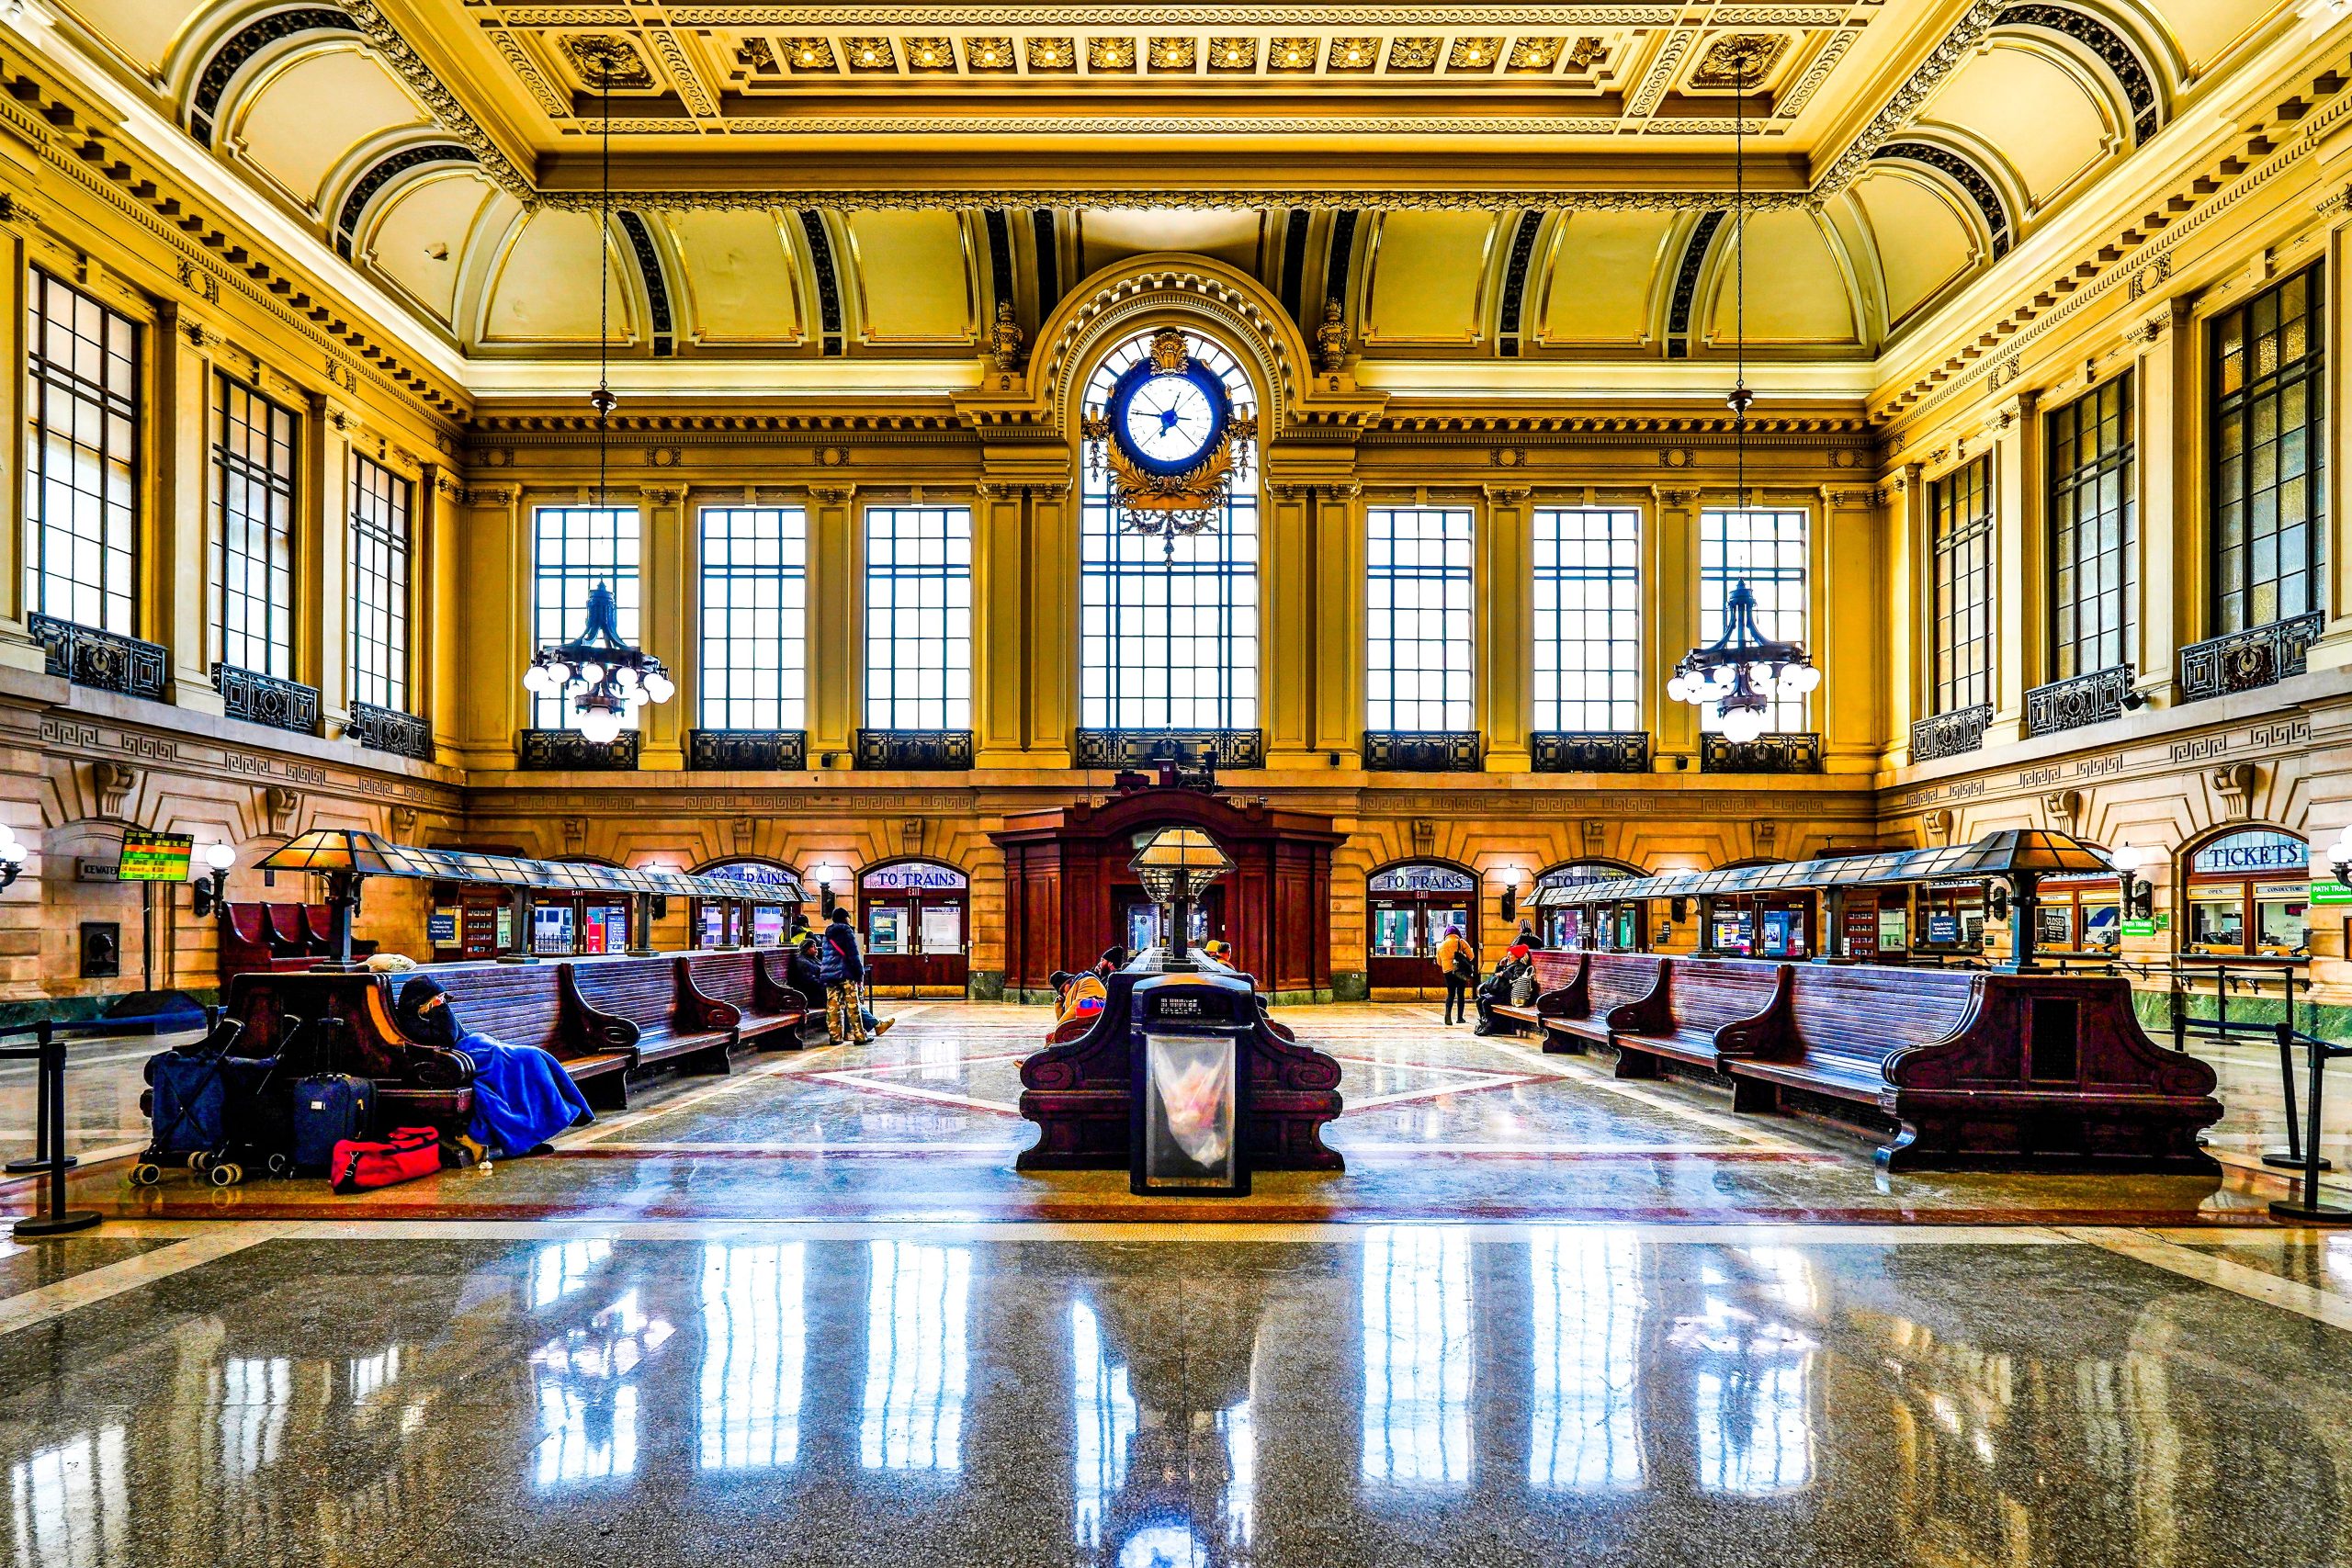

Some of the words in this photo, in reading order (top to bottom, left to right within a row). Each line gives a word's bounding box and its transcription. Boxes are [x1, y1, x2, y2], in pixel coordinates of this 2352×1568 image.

[2210, 844, 2298, 867] TICKETS
[85, 865, 95, 874] ICE
[877, 873, 898, 886] TO
[902, 873, 956, 886] TRAINS
[1384, 875, 1405, 888] TO
[1409, 875, 1464, 888] TRAINS
[1553, 875, 1574, 887] TO
[908, 887, 921, 897] EXIT
[1416, 890, 1429, 899] EXIT
[2330, 885, 2351, 893] TRAIN
[2046, 916, 2065, 927] CLOSED
